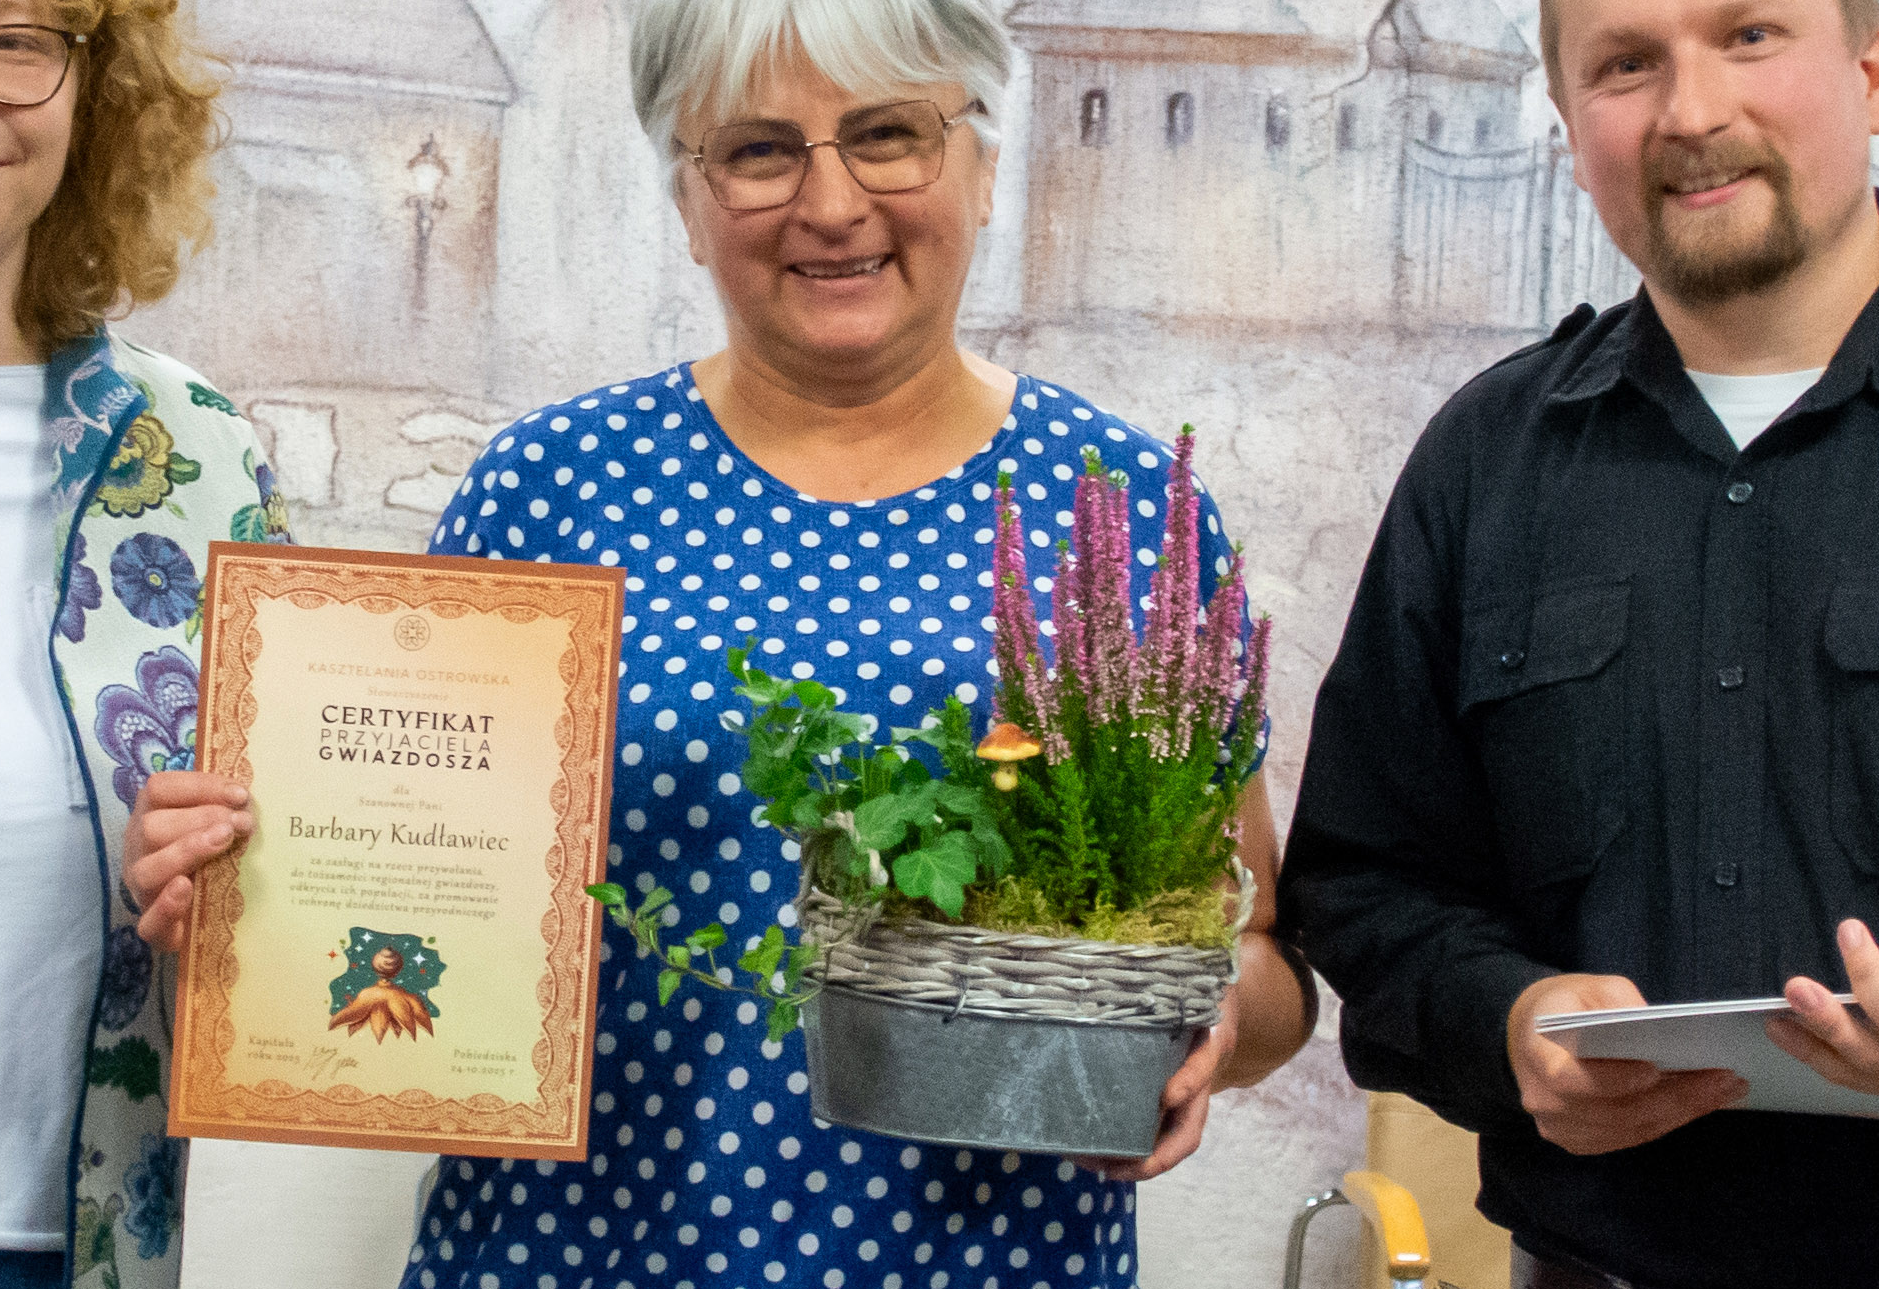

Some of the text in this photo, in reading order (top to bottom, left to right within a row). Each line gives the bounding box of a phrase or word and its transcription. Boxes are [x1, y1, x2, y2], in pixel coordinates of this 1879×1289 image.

[308, 662, 511, 685] KASZTELANIA OSTROWSKA
[320, 704, 494, 734] CERTYFIKAT
[320, 728, 492, 756] PRZYJACIELA
[318, 745, 491, 771] GWIAZDOSZA
[358, 796, 443, 812] Szanownej Pani
[288, 813, 509, 851] Barbary Kudławiec
[325, 855, 364, 871] zasługi
[384, 863, 412, 871] rzecz
[290, 866, 304, 878] do
[370, 871, 431, 889] regionalnej
[288, 881, 336, 896] odkrycia
[340, 884, 356, 894] ich
[418, 892, 429, 900] za
[433, 891, 498, 906] promowanie
[345, 898, 409, 912] dziedzictwa
[412, 903, 496, 921] przyrodniczego
[247, 1049, 271, 1060] roku
[453, 1046, 517, 1062] Pobiedziska
